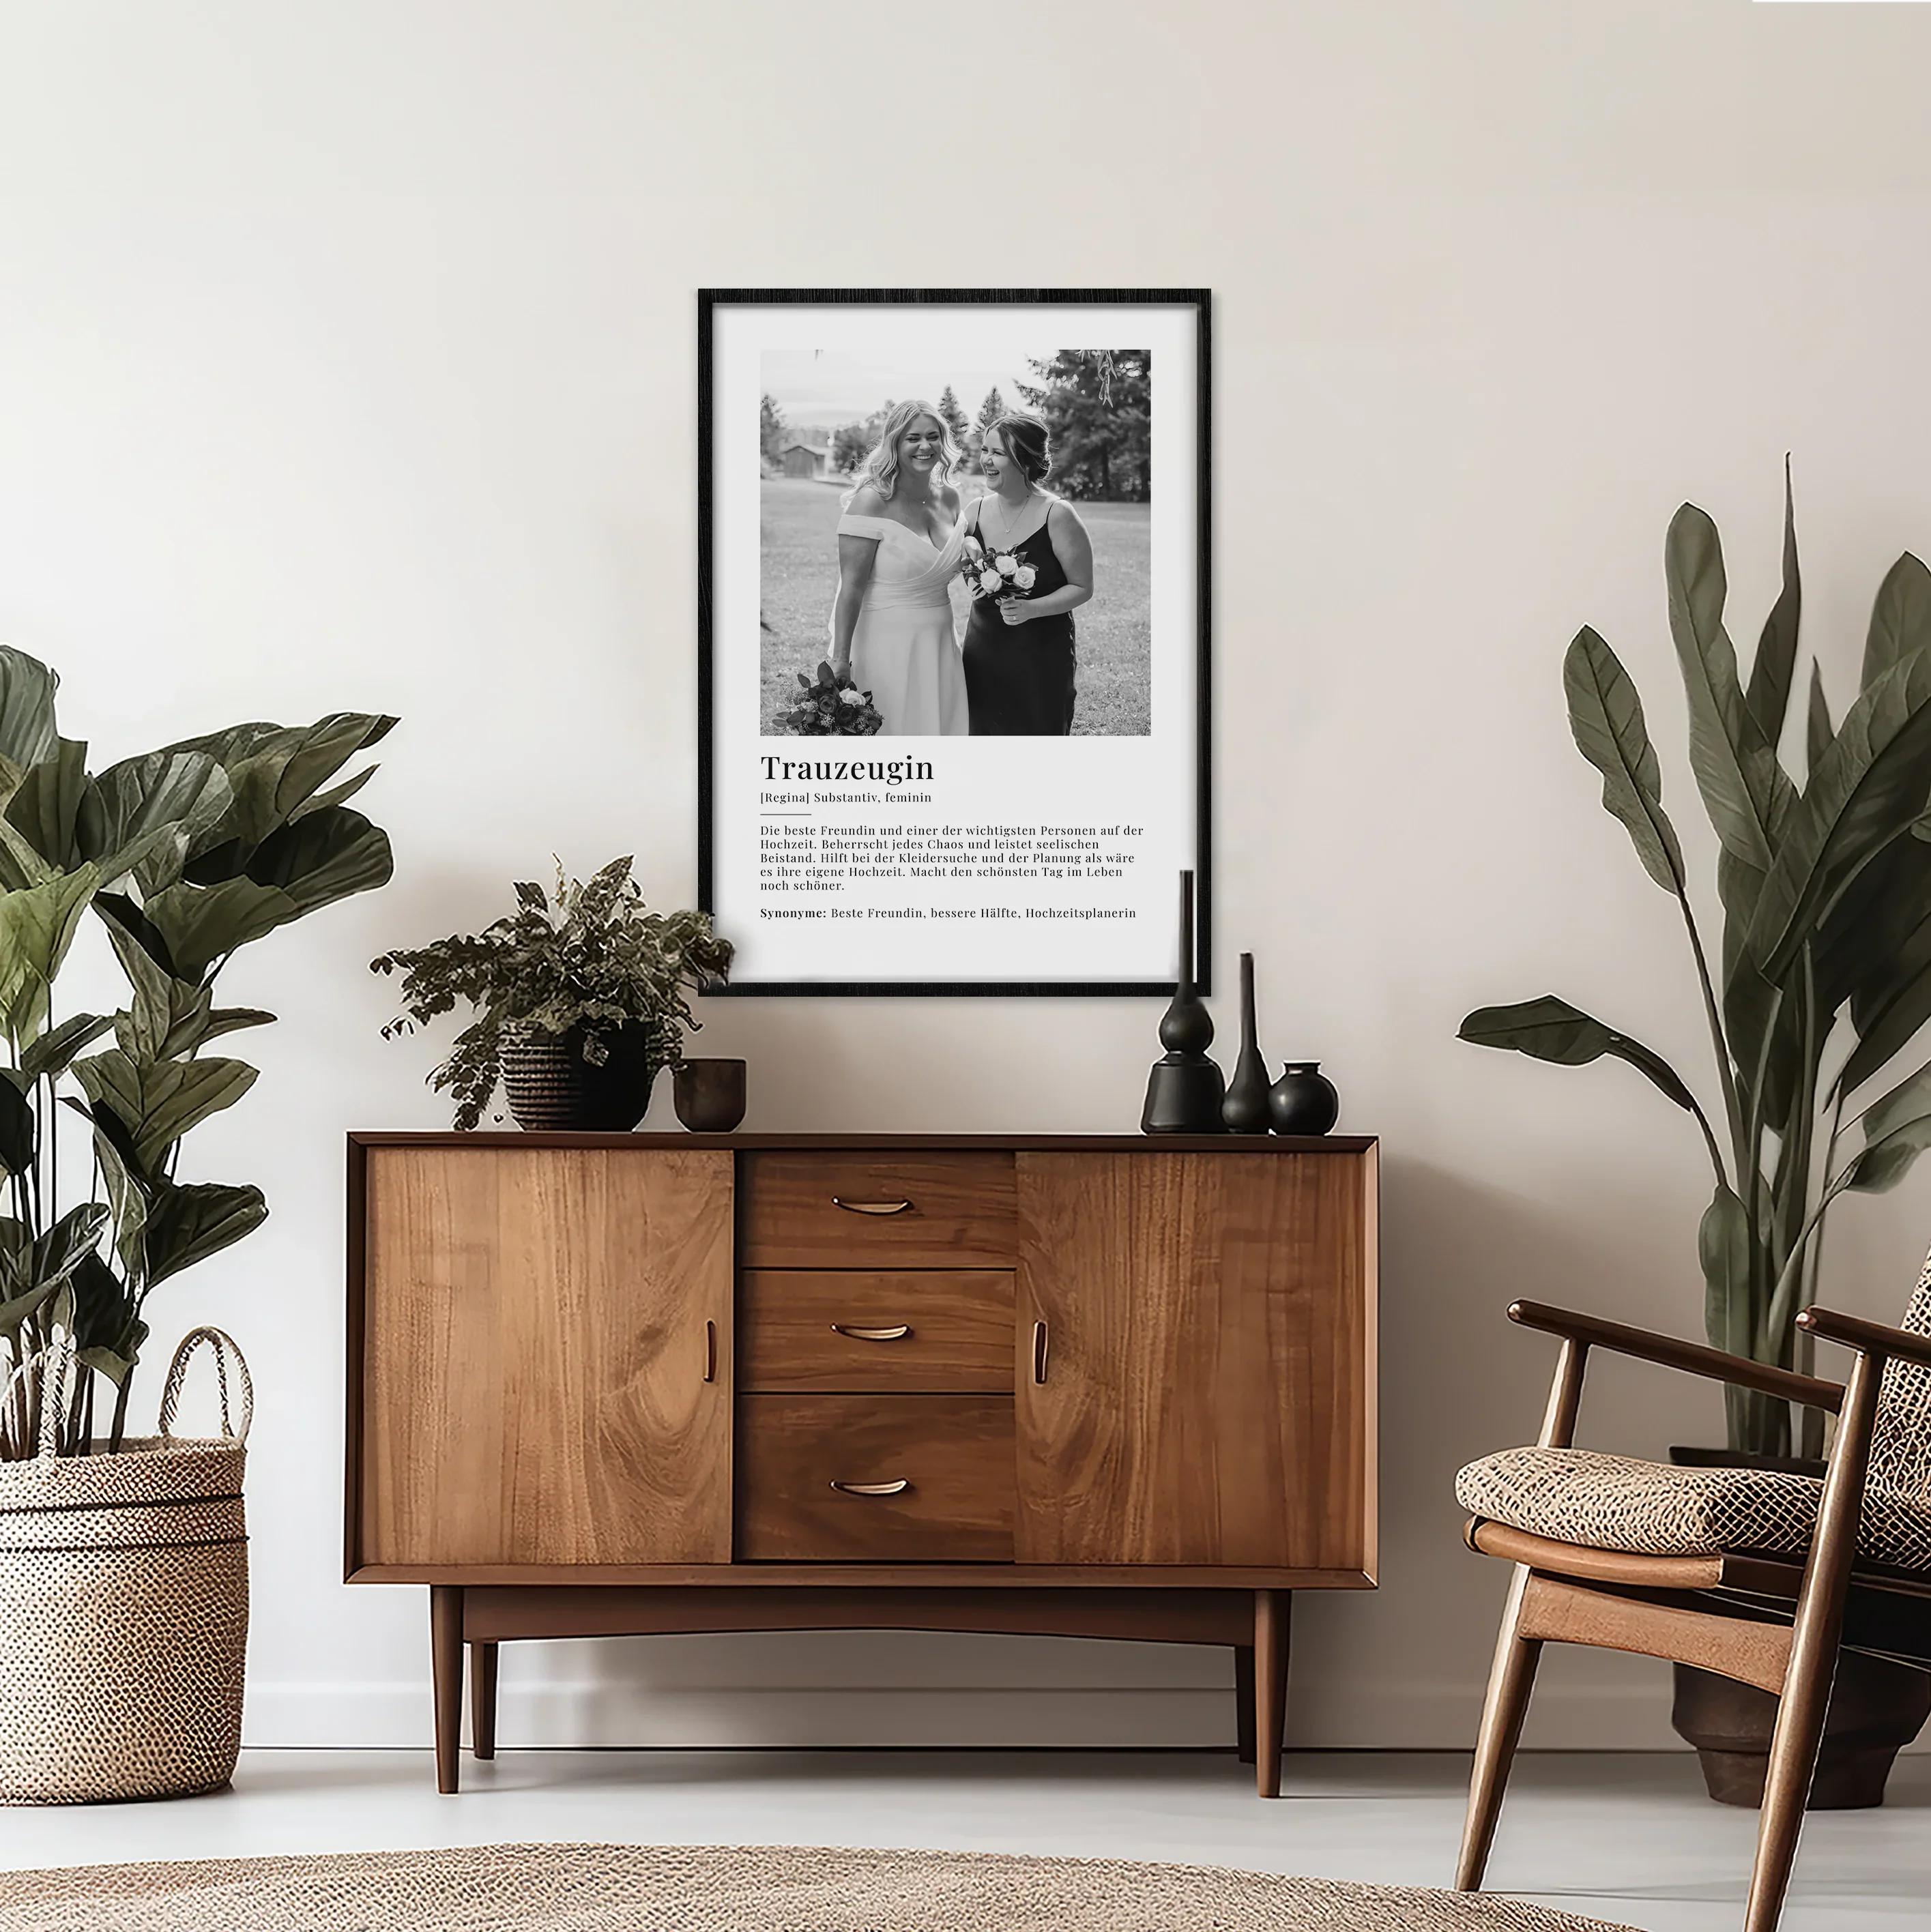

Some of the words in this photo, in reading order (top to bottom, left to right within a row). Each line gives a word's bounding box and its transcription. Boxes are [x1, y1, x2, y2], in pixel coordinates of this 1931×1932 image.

[761, 755, 934, 786] Trauzeugin
[761, 792, 809, 804] [Regina]
[814, 792, 881, 804] Substantiv,
[886, 792, 931, 803] feminin
[761, 825, 780, 836] Die
[784, 825, 816, 836] beste
[821, 825, 875, 836] Freundin
[880, 825, 902, 836] und
[906, 825, 938, 836] einer
[942, 825, 963, 836] der
[966, 825, 1036, 837] wichtigsten
[1041, 825, 1096, 836] Personen
[1100, 825, 1120, 836] auf
[1123, 825, 1144, 836] der
[761, 838, 817, 849] Hochzeit.
[822, 838, 888, 849] Beherrscht
[892, 838, 923, 851] jedes
[927, 838, 963, 849] Chaos
[968, 838, 990, 849] und
[995, 838, 1032, 849] leistet
[1036, 838, 1099, 849] seelischen
[761, 853, 816, 863] Beistand.
[821, 853, 849, 863] Hilft
[852, 853, 870, 863] bei
[874, 853, 895, 863] der
[899, 853, 977, 863] Kleidersuche
[982, 853, 1004, 863] und
[1008, 853, 1029, 863] der
[1033, 853, 1081, 865] Planung
[1085, 853, 1102, 863] als
[1105, 853, 1135, 863] wäre
[777, 866, 801, 877] ihre
[805, 866, 844, 879] eigene
[849, 866, 905, 877] Hochzeit.
[910, 866, 947, 877] Macht
[950, 866, 972, 877] den
[976, 866, 1037, 877] schönsten
[1041, 867, 1063, 879] Tag
[1067, 866, 1082, 877] im
[1087, 866, 1122, 877] Leben
[760, 880, 789, 891] noch
[794, 880, 845, 891] schöner.
[760, 908, 826, 920] Synonyme:
[831, 908, 863, 918] Beste
[868, 907, 927, 919] Freundin,
[931, 907, 976, 918] bessere
[981, 907, 1021, 920] Hälfte,
[1026, 907, 1136, 920] Hochzeitsplanerin
